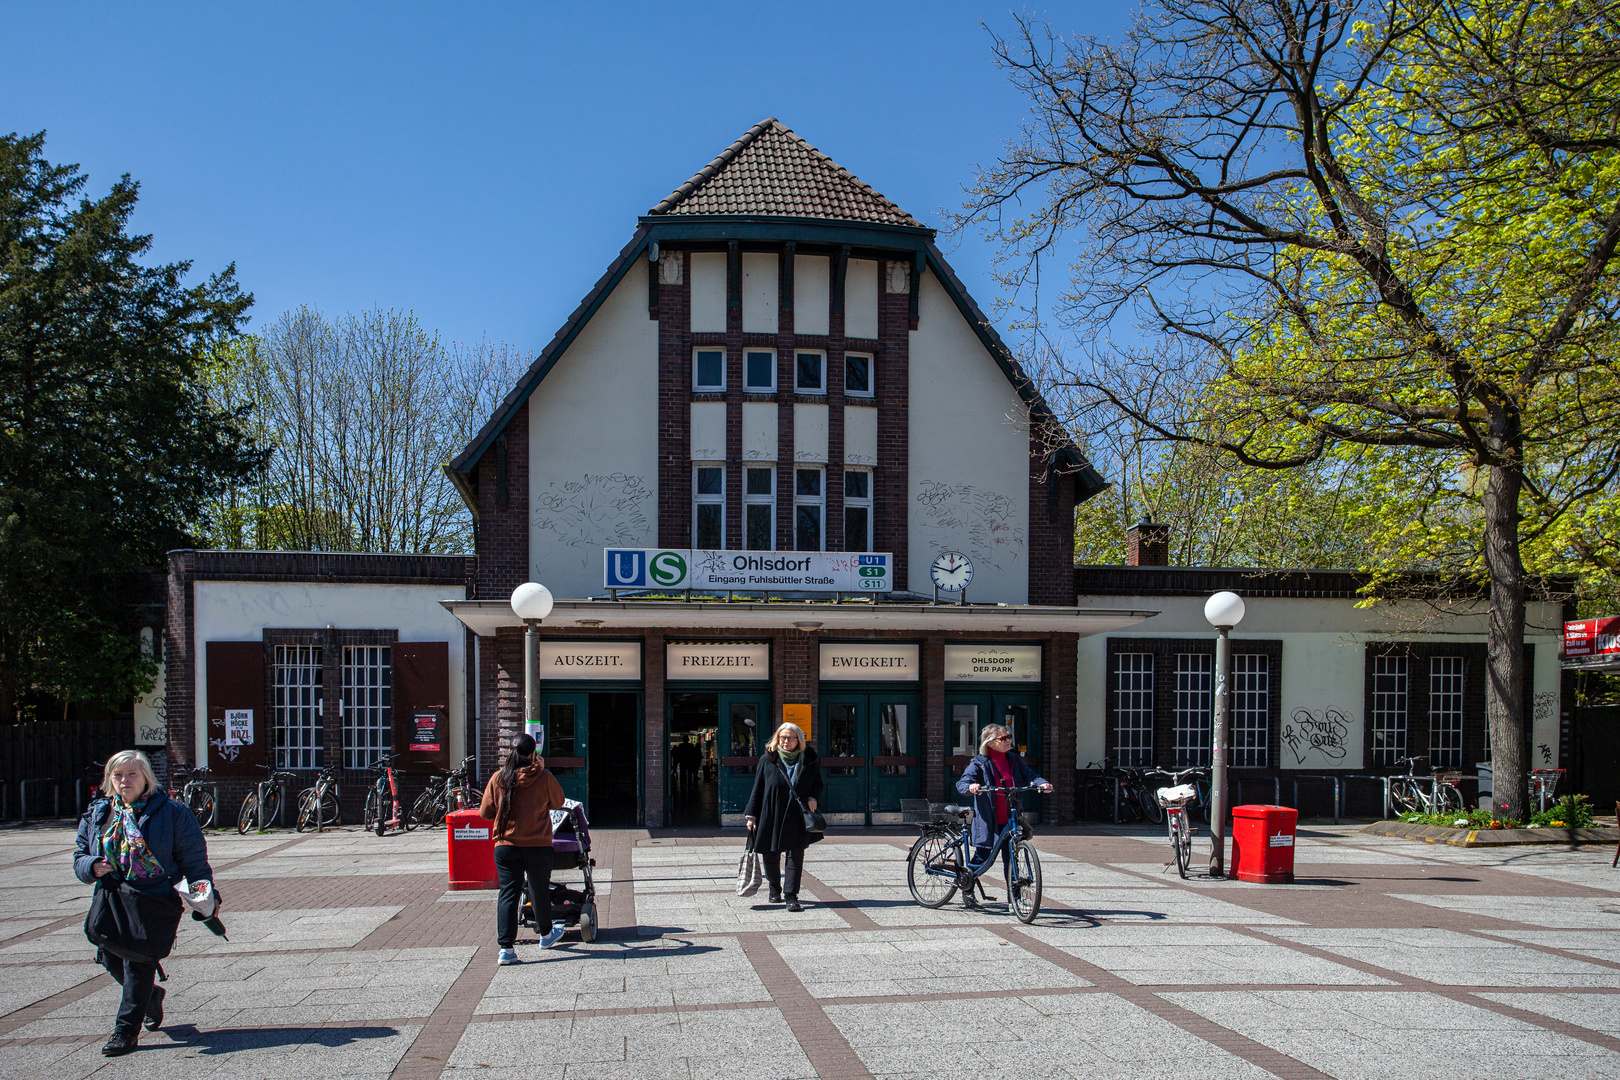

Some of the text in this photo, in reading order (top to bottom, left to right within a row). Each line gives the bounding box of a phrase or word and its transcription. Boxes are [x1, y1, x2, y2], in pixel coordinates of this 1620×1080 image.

[614, 553, 639, 584] U
[654, 552, 682, 585] S
[733, 555, 811, 571] Ohlsdorf
[708, 574, 835, 585] Eingang Fuhlsbüttler Straße
[554, 655, 623, 667] AUSZEIT.
[682, 655, 754, 667] FREIZEIT.
[831, 656, 907, 668] EWIGKEIT.
[230, 712, 248, 720] BJÖRN
[230, 719, 248, 727] HÖCKE
[230, 729, 249, 739] NAZI
